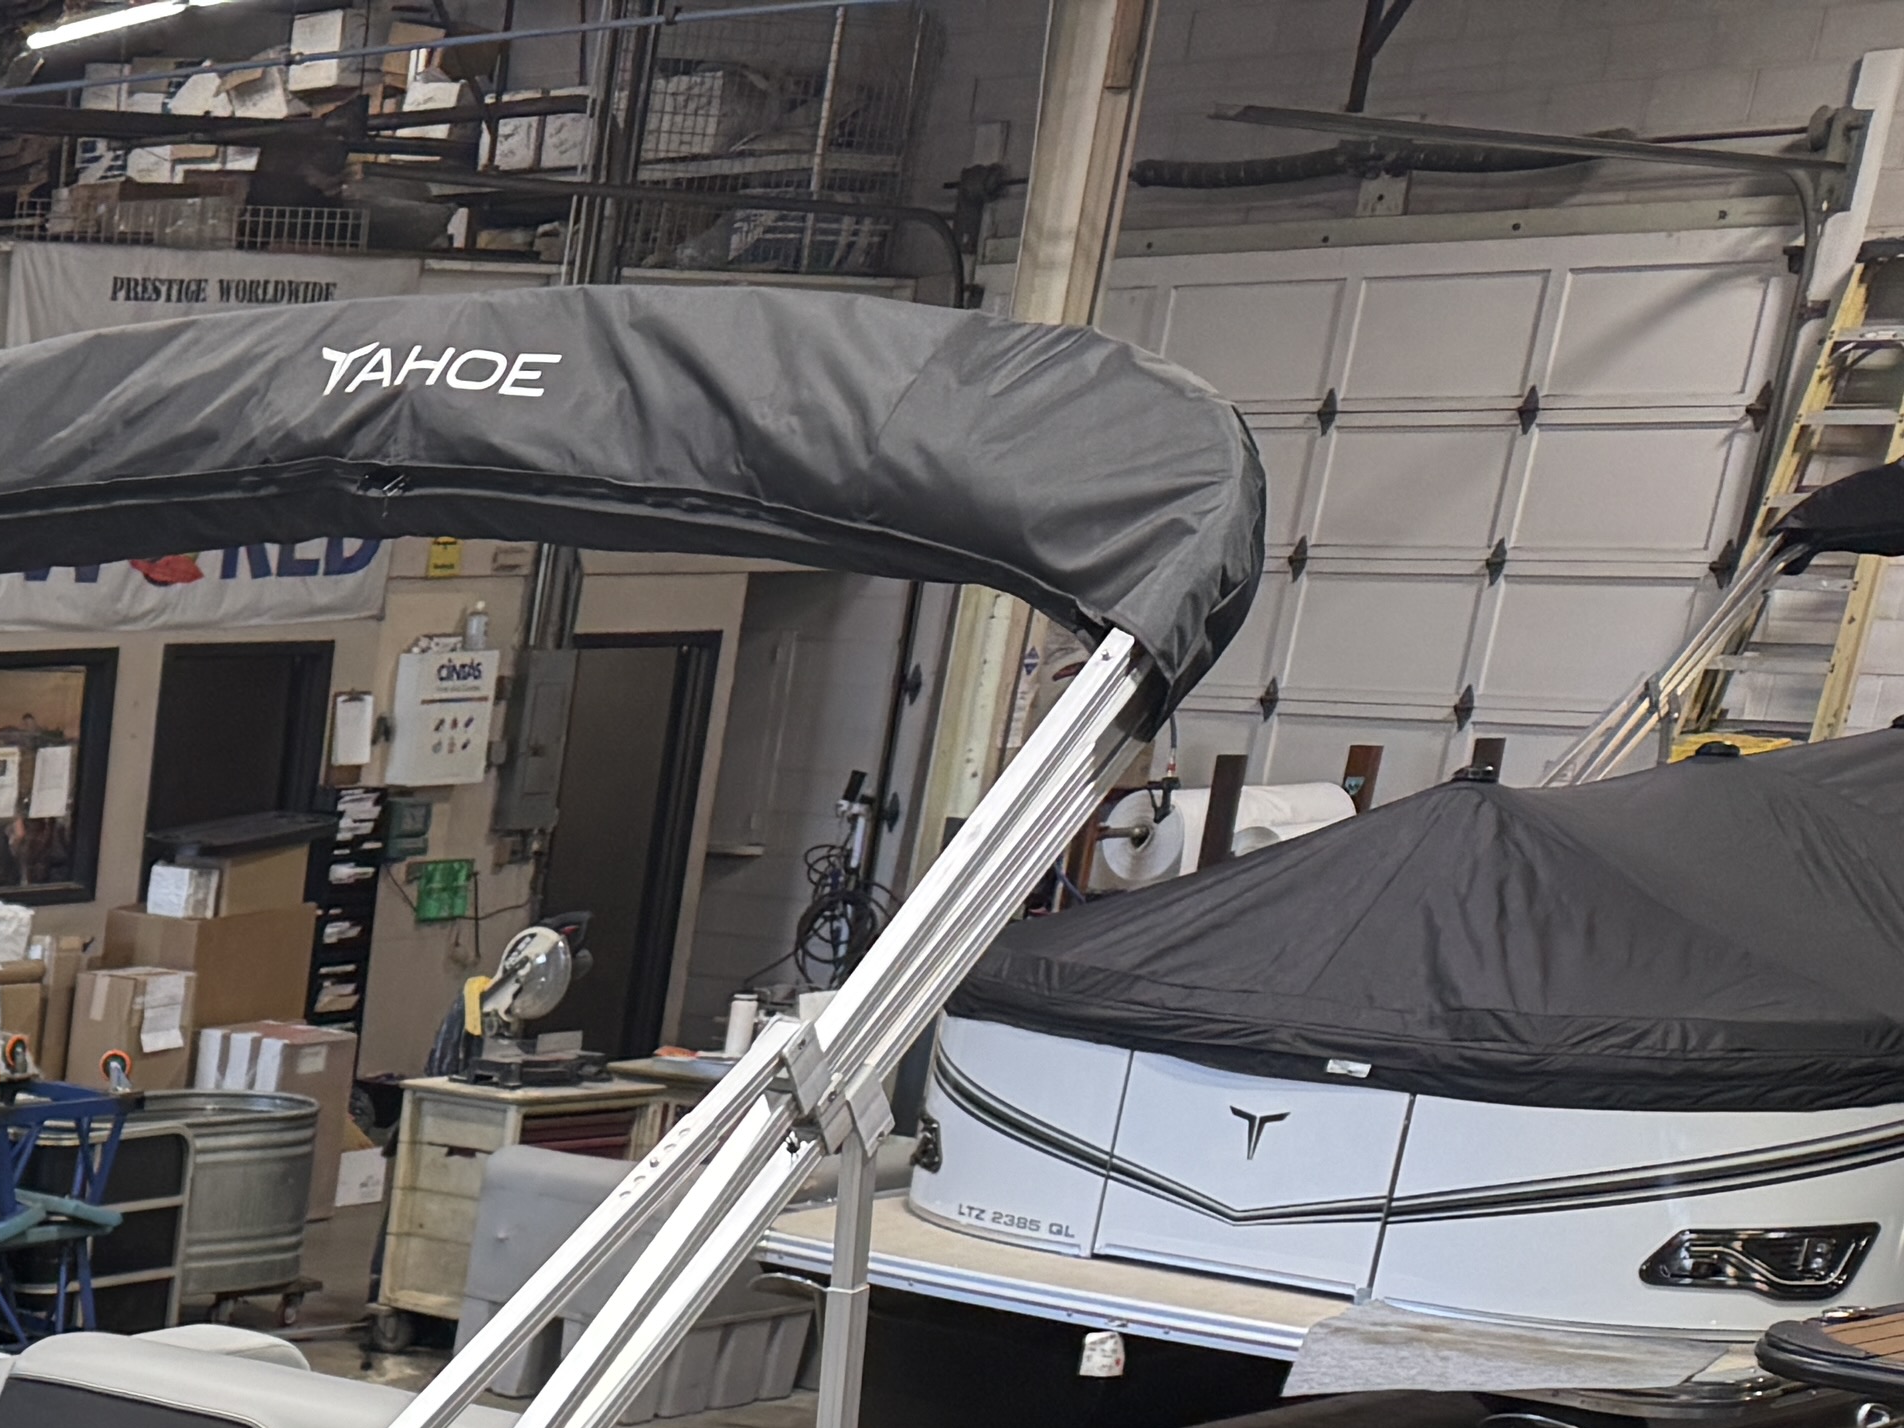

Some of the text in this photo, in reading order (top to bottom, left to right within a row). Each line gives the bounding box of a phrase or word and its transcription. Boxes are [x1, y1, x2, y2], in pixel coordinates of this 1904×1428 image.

[110, 276, 337, 304] PRESTIGE WORLDWIDE
[322, 341, 563, 397] TAHOE
[958, 1203, 986, 1221] LTZ
[991, 1211, 1041, 1232] 2385
